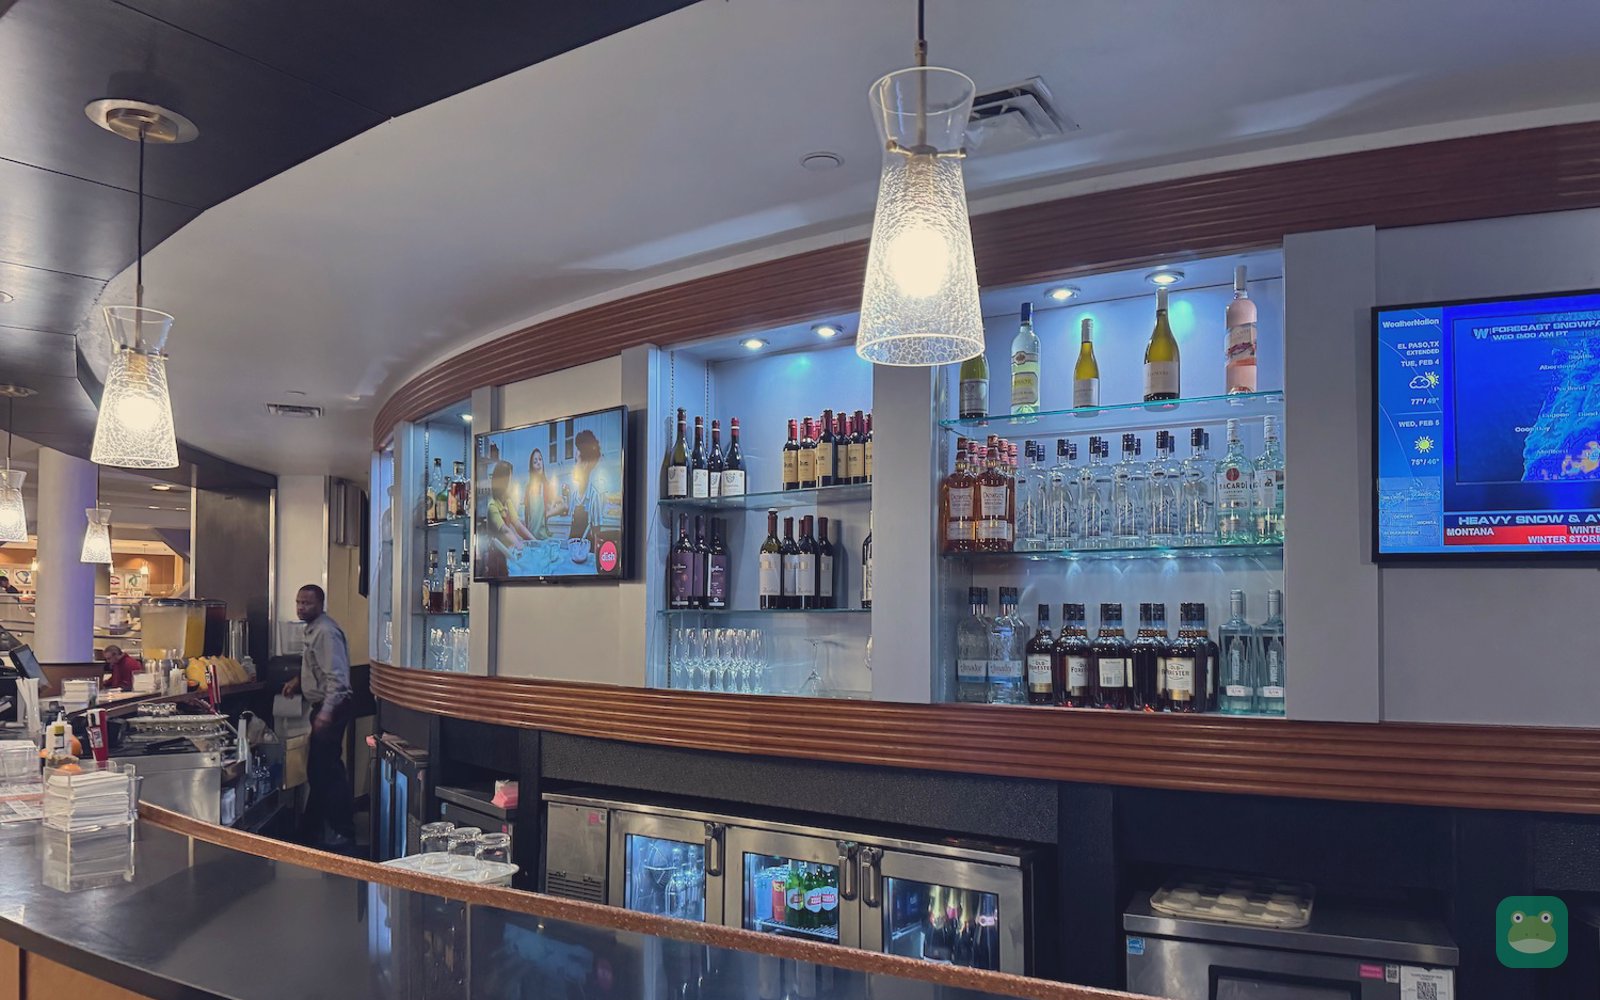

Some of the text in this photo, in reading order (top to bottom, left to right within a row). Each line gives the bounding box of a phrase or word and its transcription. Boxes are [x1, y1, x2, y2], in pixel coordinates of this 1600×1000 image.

[1382, 318, 1439, 328] WeatherNation
[1492, 323, 1550, 333] FORECAST
[1406, 348, 1440, 356] EXTENDED
[1418, 419, 1434, 427] FEB
[1458, 515, 1511, 525] HEAVY
[1515, 514, 1564, 524] SNOW
[1568, 513, 1581, 523] &
[1446, 527, 1495, 536] MONTANA
[1527, 535, 1567, 544] WINTER
